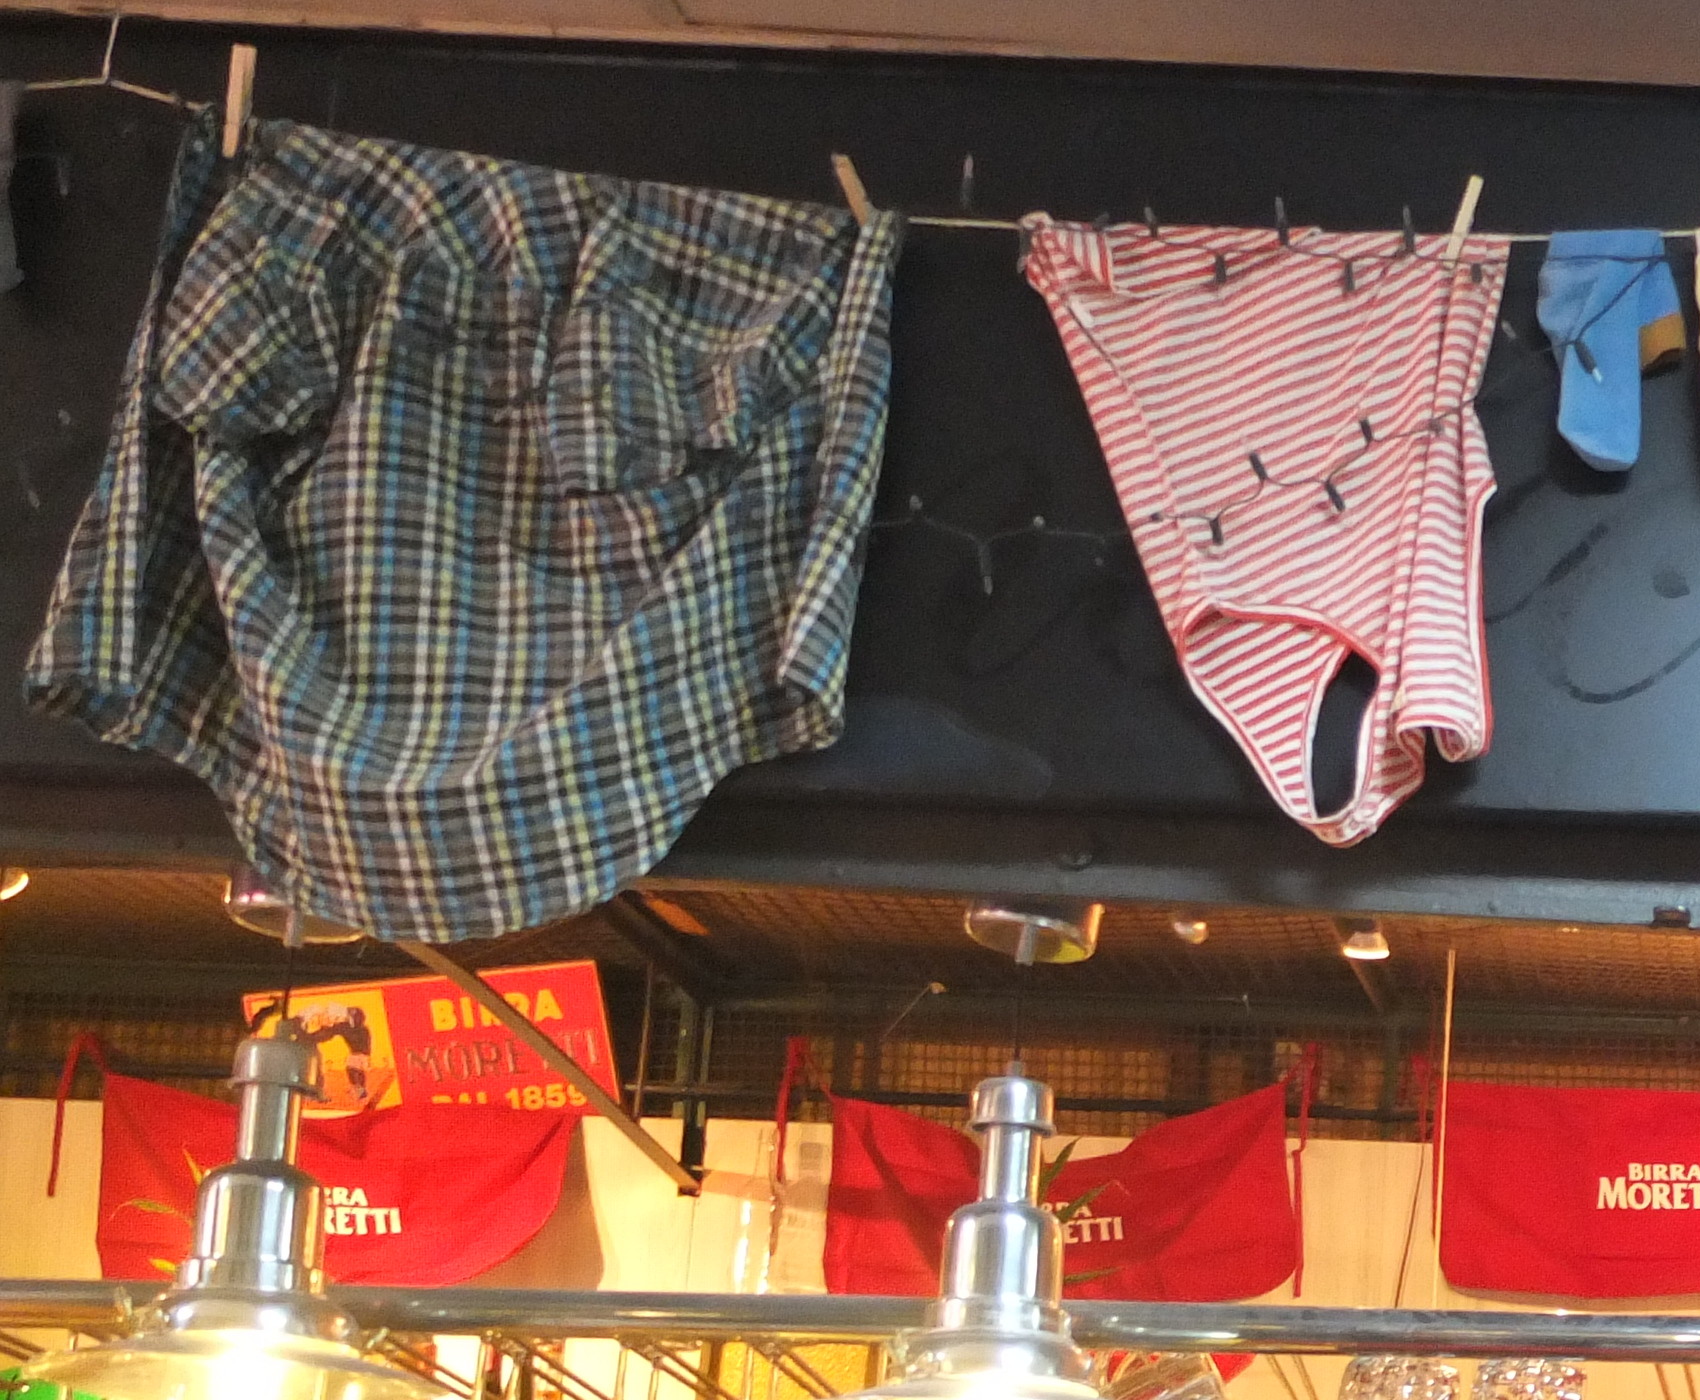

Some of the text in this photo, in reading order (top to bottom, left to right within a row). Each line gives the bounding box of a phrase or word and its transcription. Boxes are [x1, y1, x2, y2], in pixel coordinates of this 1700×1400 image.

[407, 1027, 600, 1084] MORETI
[324, 1207, 402, 1235] RETTI
[1063, 1216, 1123, 1244] ETTI
